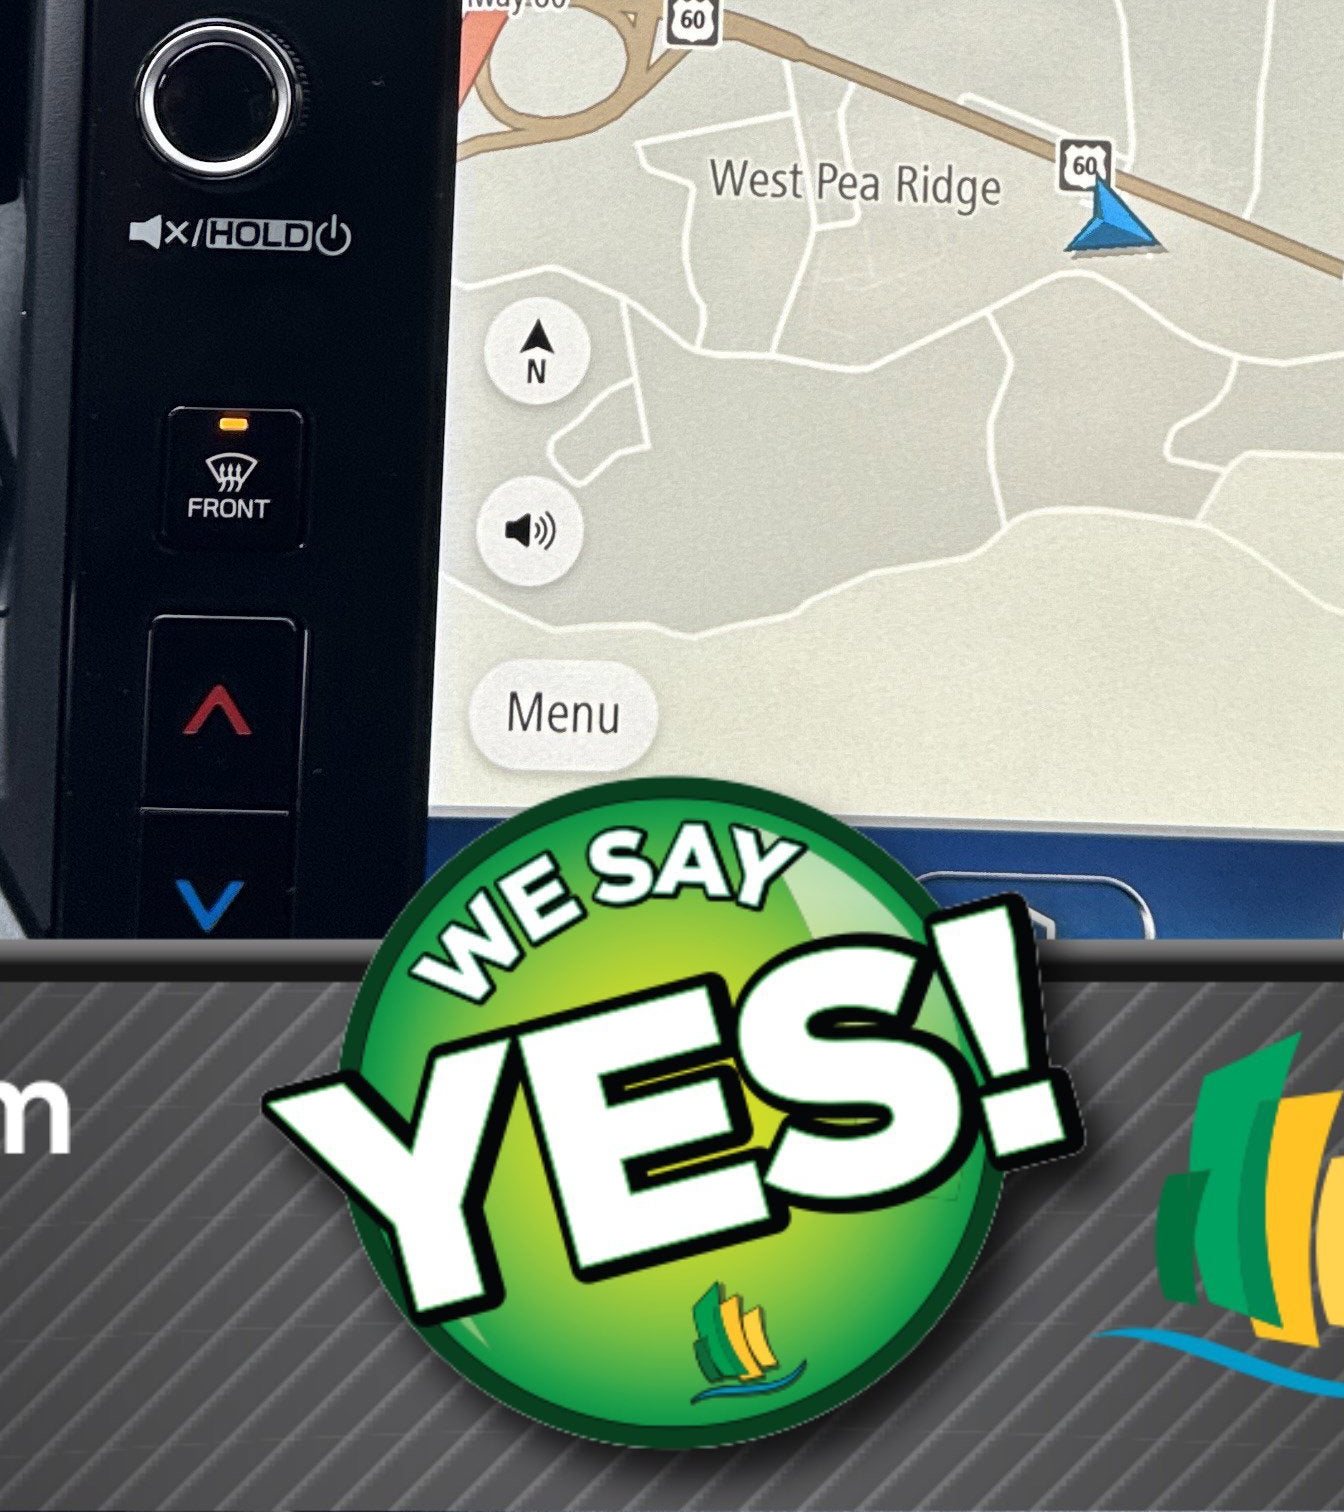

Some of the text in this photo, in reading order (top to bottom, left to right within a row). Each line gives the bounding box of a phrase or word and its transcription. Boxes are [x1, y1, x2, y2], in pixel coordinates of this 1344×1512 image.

[680, 9, 706, 30] 60
[1073, 155, 1098, 176] 60
[710, 158, 1001, 217] West Pea Ridge
[208, 220, 310, 249] HOLD
[527, 358, 546, 384] N
[187, 497, 271, 519] FRONT
[508, 691, 620, 735] Menu
